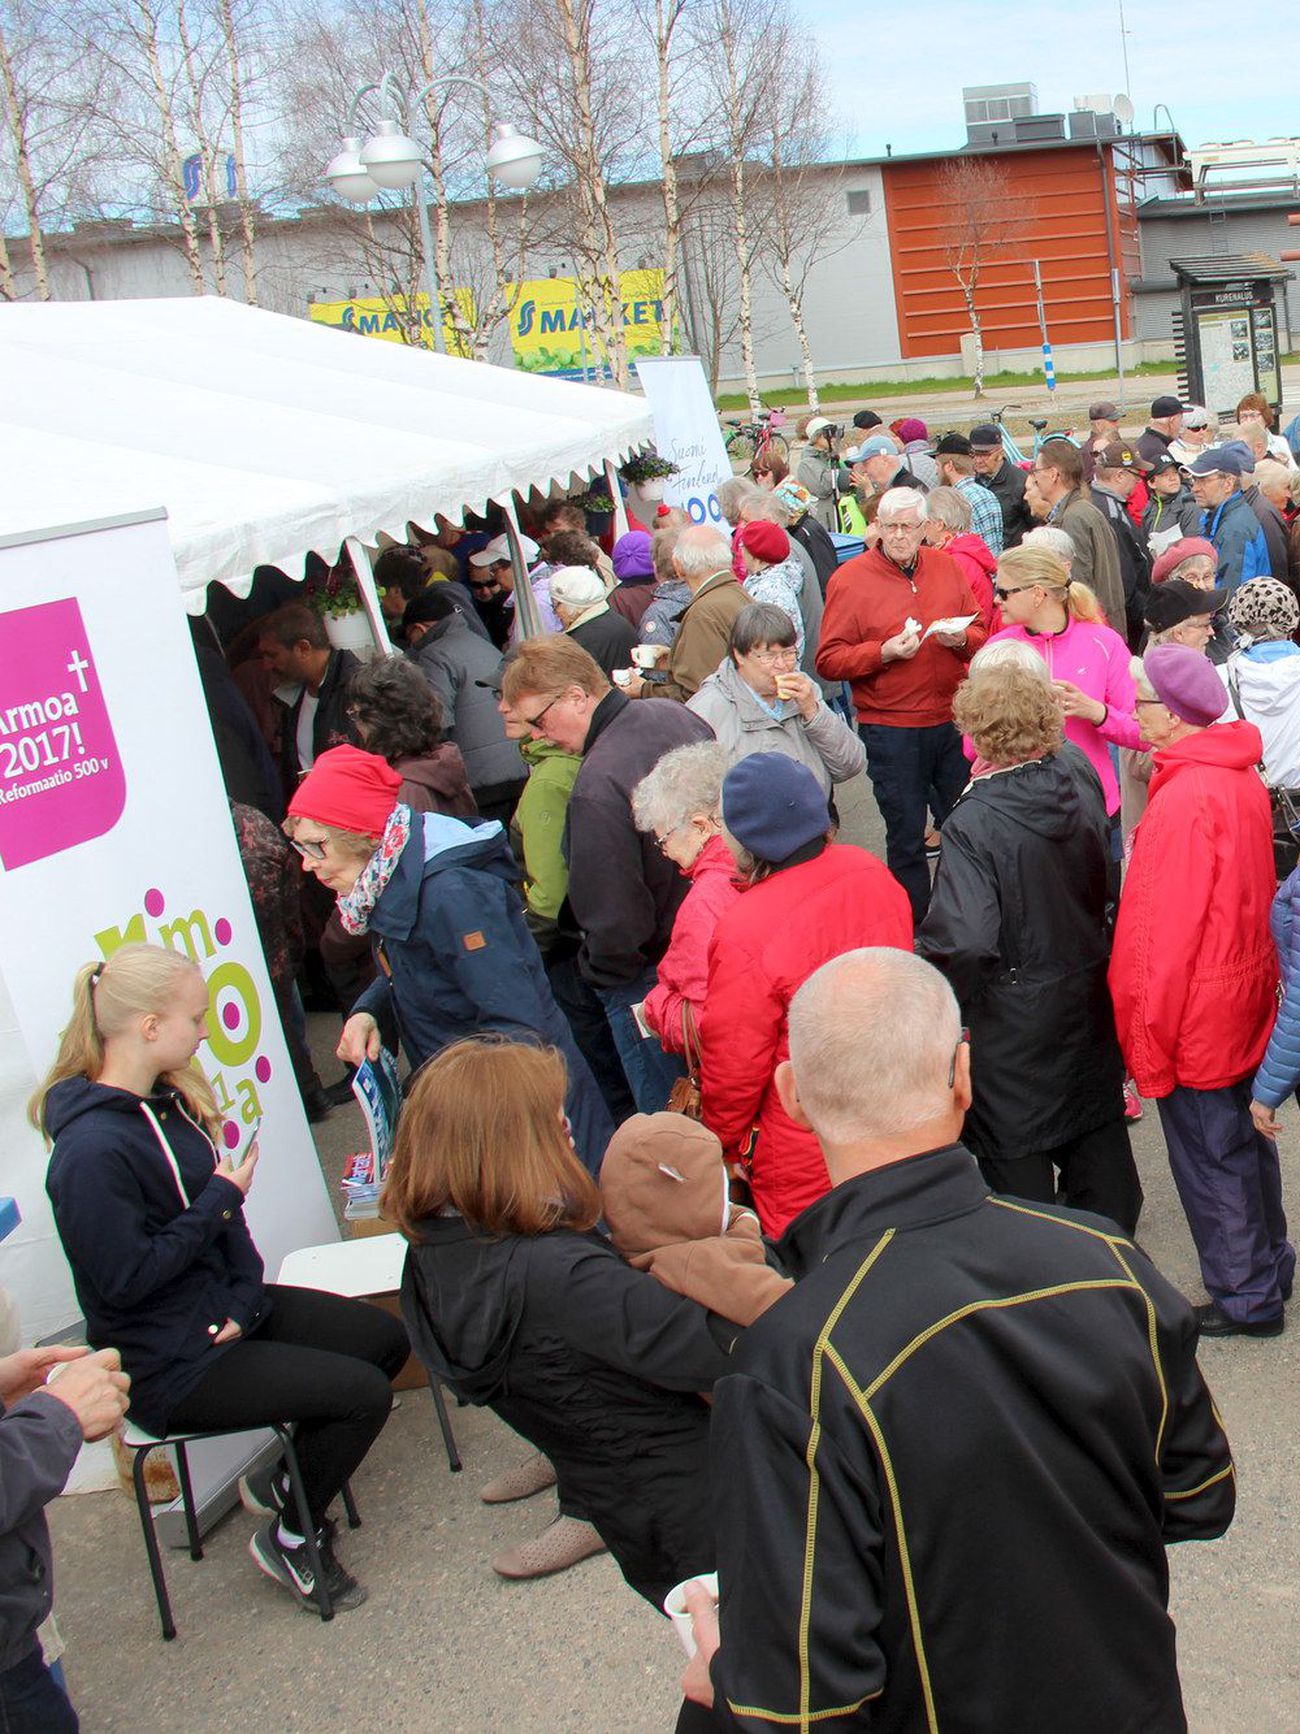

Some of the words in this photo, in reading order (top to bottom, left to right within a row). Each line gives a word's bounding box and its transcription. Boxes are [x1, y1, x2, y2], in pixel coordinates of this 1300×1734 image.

[540, 300, 664, 333] MAKET
[0, 721, 86, 779] 2017!
[73, 756, 100, 780] 500
[100, 757, 109, 770] v
